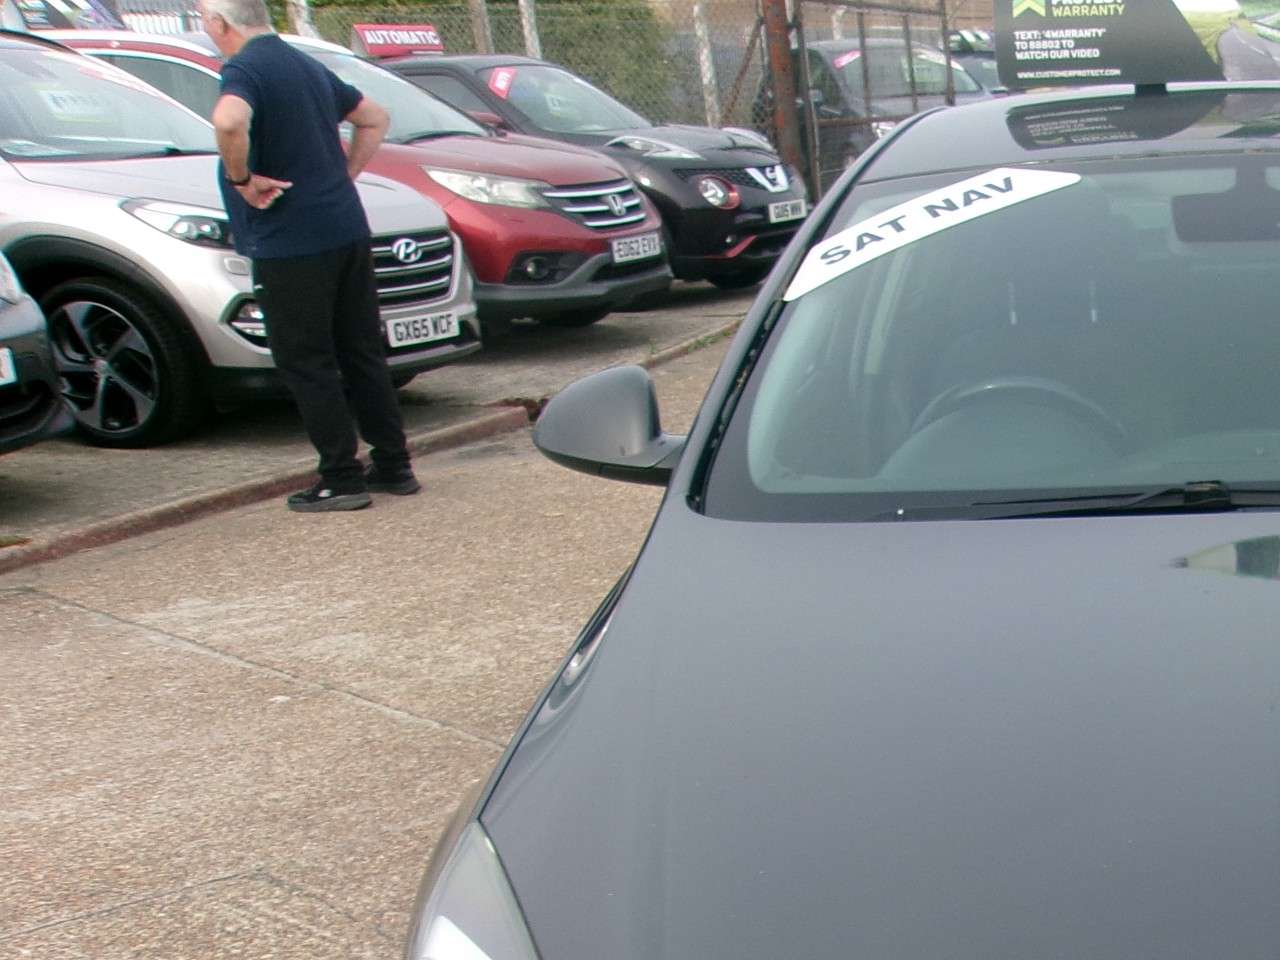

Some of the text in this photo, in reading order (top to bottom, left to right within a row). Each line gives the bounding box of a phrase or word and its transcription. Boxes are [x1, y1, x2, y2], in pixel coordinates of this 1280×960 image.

[1052, 4, 1125, 17] WARRANTY
[363, 30, 441, 45] AUTOMATIC
[1014, 31, 1042, 40] TEXT:
[1015, 41, 1028, 50] TO
[1061, 39, 1075, 49] TO
[1015, 49, 1100, 60] WATCH OUR VIDEO
[820, 176, 1015, 265] SAT NAV
[393, 314, 453, 342] GX65 WCF
